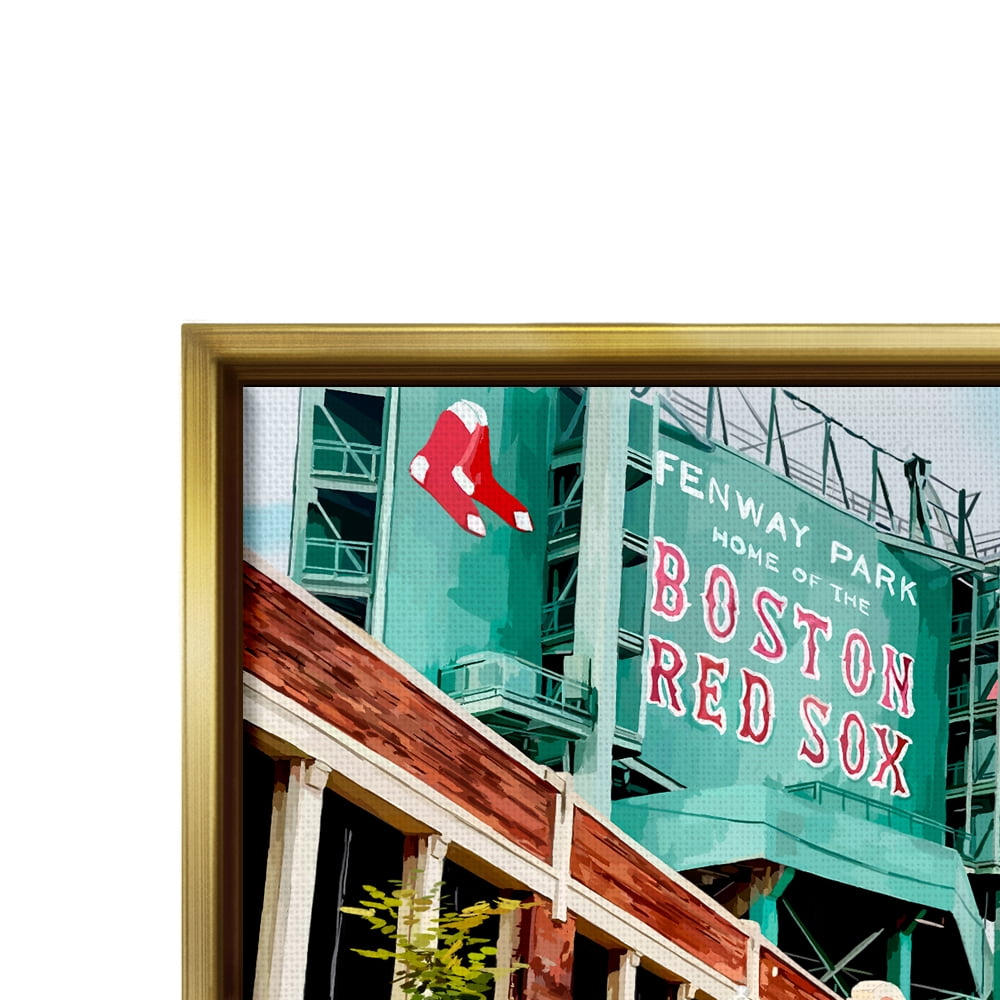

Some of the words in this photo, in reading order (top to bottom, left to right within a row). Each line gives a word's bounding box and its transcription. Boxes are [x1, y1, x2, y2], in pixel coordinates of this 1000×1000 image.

[655, 450, 810, 548] FENWAY
[830, 541, 917, 606] PARK
[712, 526, 779, 574] HOME
[792, 567, 822, 588] OF
[830, 583, 870, 616] THE
[650, 536, 916, 718] BOSTON
[648, 634, 775, 746] RED
[797, 695, 914, 798] SOX
